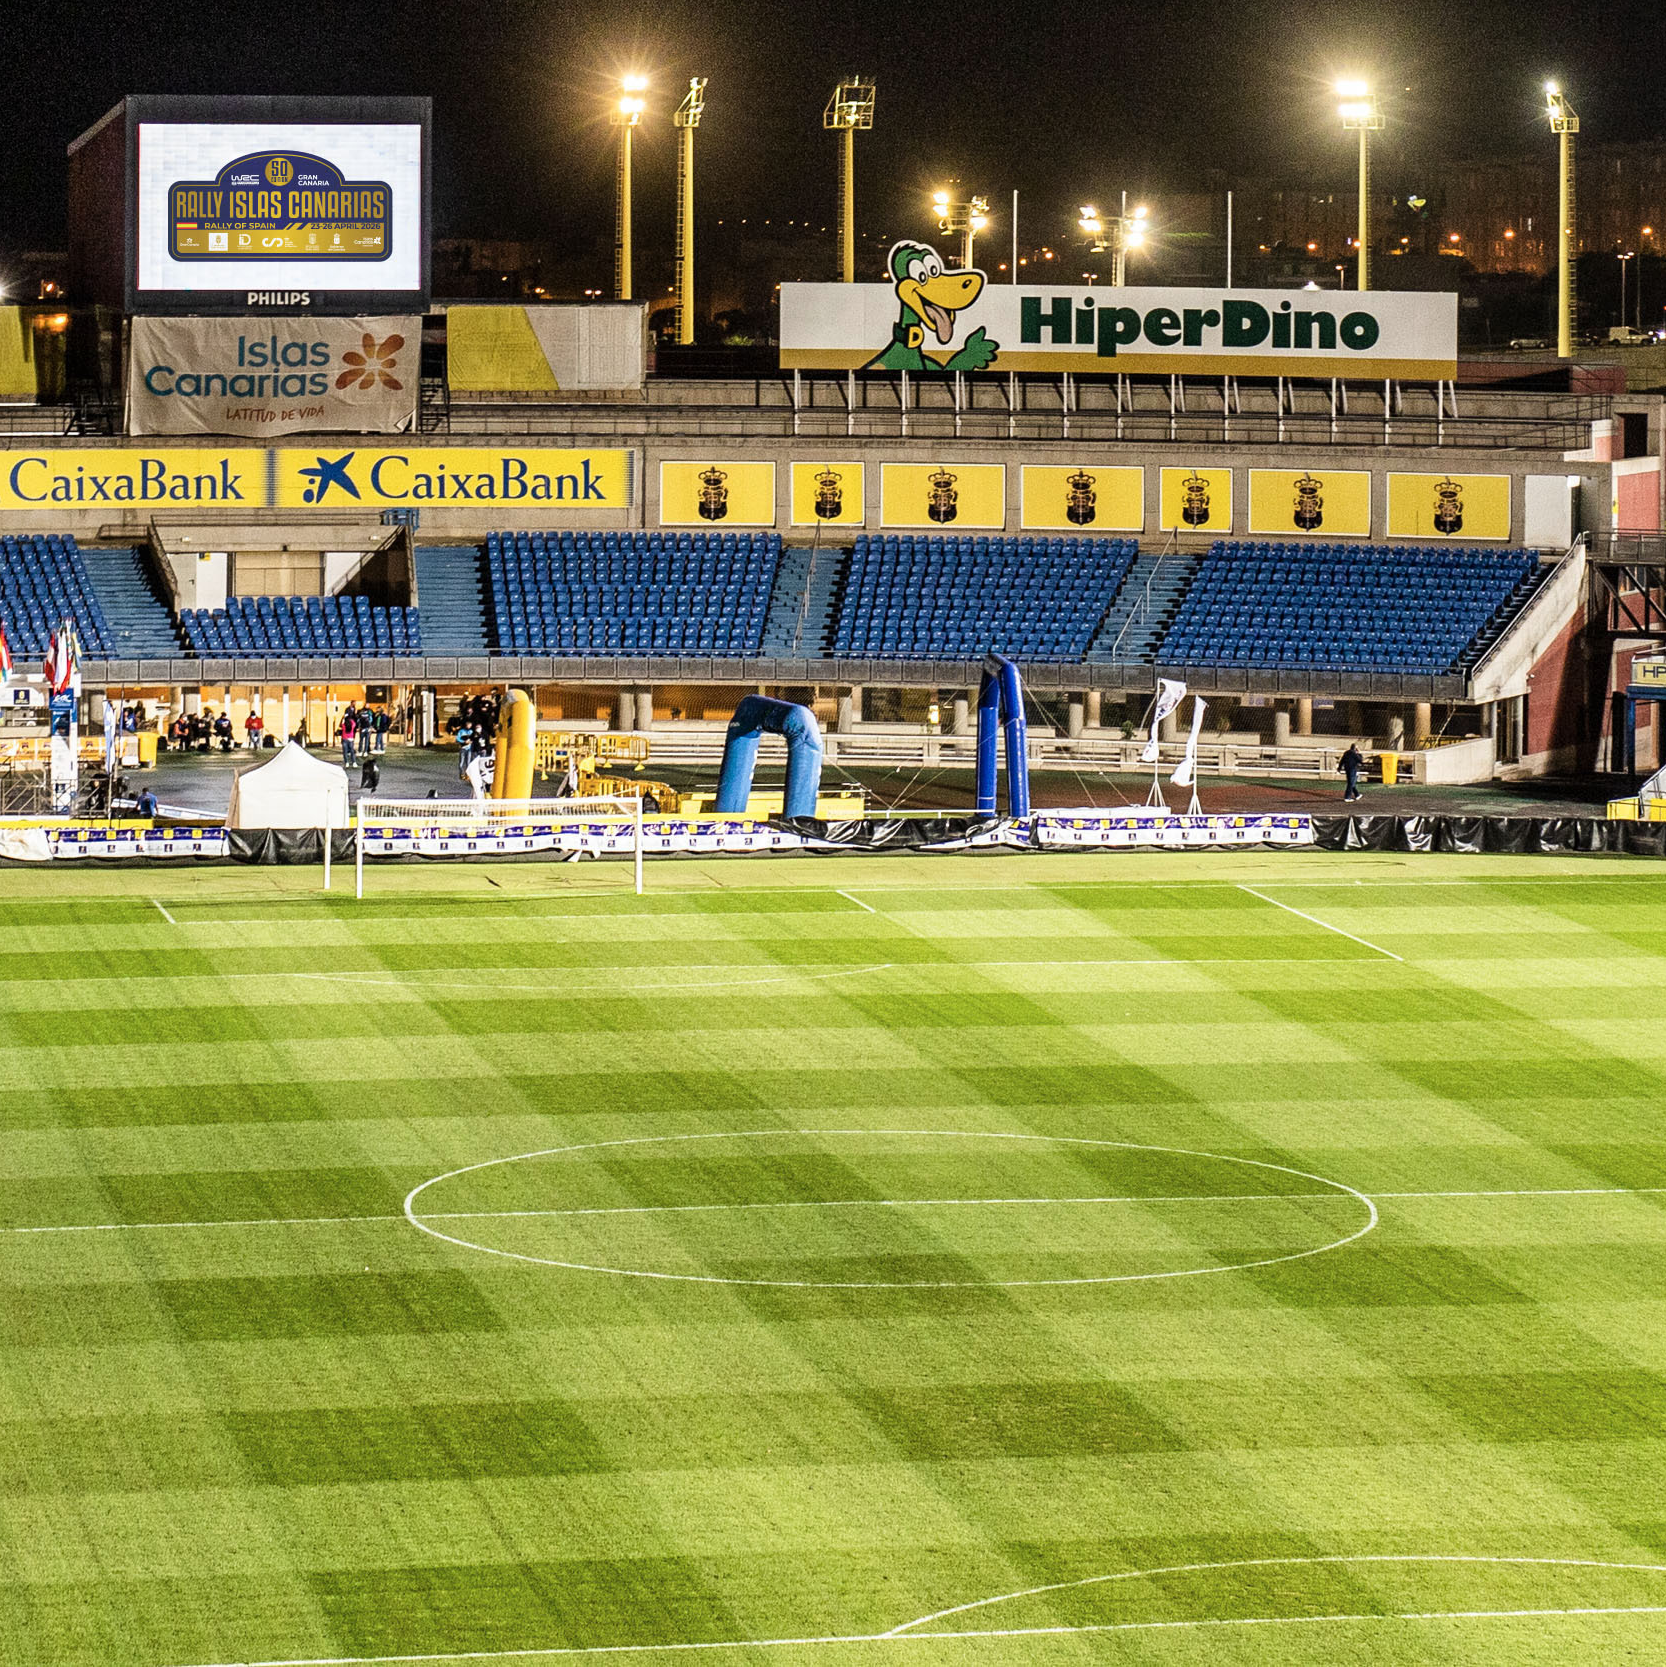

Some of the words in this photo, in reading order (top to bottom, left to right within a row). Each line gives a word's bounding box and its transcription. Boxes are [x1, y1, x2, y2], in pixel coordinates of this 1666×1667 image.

[271, 160, 288, 176] 50
[176, 191, 224, 219] RALLY
[229, 191, 282, 219] ISLAS
[288, 191, 384, 219] CANARIAS
[204, 222, 232, 230] RALLY
[234, 222, 247, 230] OF
[248, 222, 276, 230] SPAIN
[311, 222, 333, 230] 23-26
[333, 222, 360, 230] APRIL
[360, 222, 381, 230] 2026
[247, 292, 311, 306] PHILIPS
[1020, 296, 1380, 358] HiperDino
[238, 335, 331, 367] Islas
[145, 365, 329, 397] Canarias
[226, 407, 276, 422] LATITUD
[281, 407, 295, 421] DE
[298, 405, 325, 419] VIDA
[8, 456, 246, 502] CaixaBank
[369, 455, 607, 501] CaixaBank
